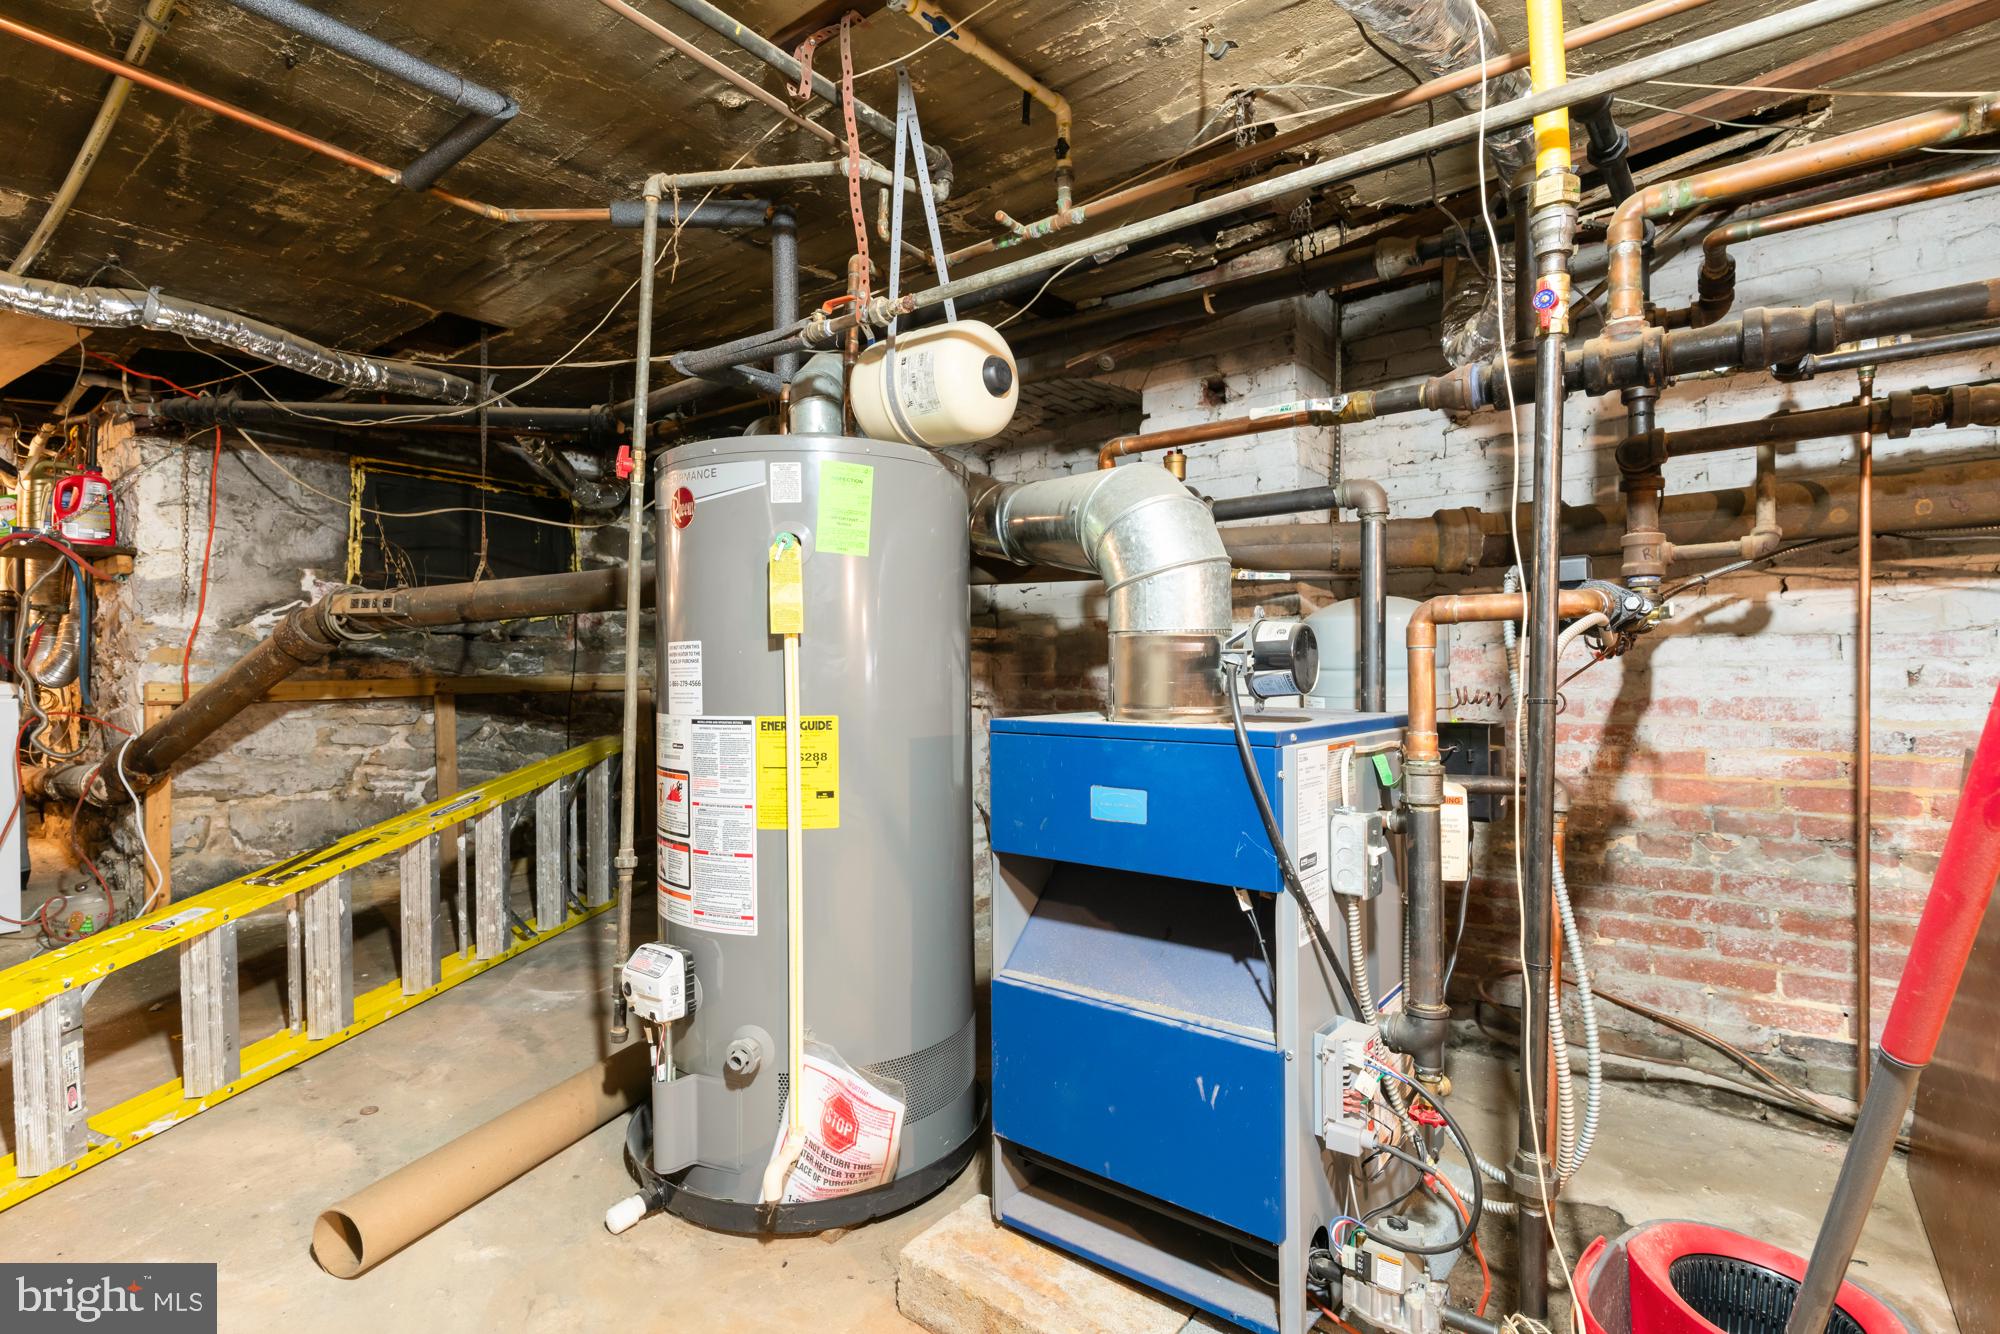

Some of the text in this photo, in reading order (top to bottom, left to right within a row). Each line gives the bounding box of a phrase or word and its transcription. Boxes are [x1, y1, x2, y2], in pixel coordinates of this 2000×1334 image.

[825, 1108, 853, 1136] STOP
[809, 1140, 820, 1154] NOT
[820, 1151, 851, 1170] RETURN
[813, 1172, 822, 1183] OF
[815, 1159, 842, 1179] HEATER
